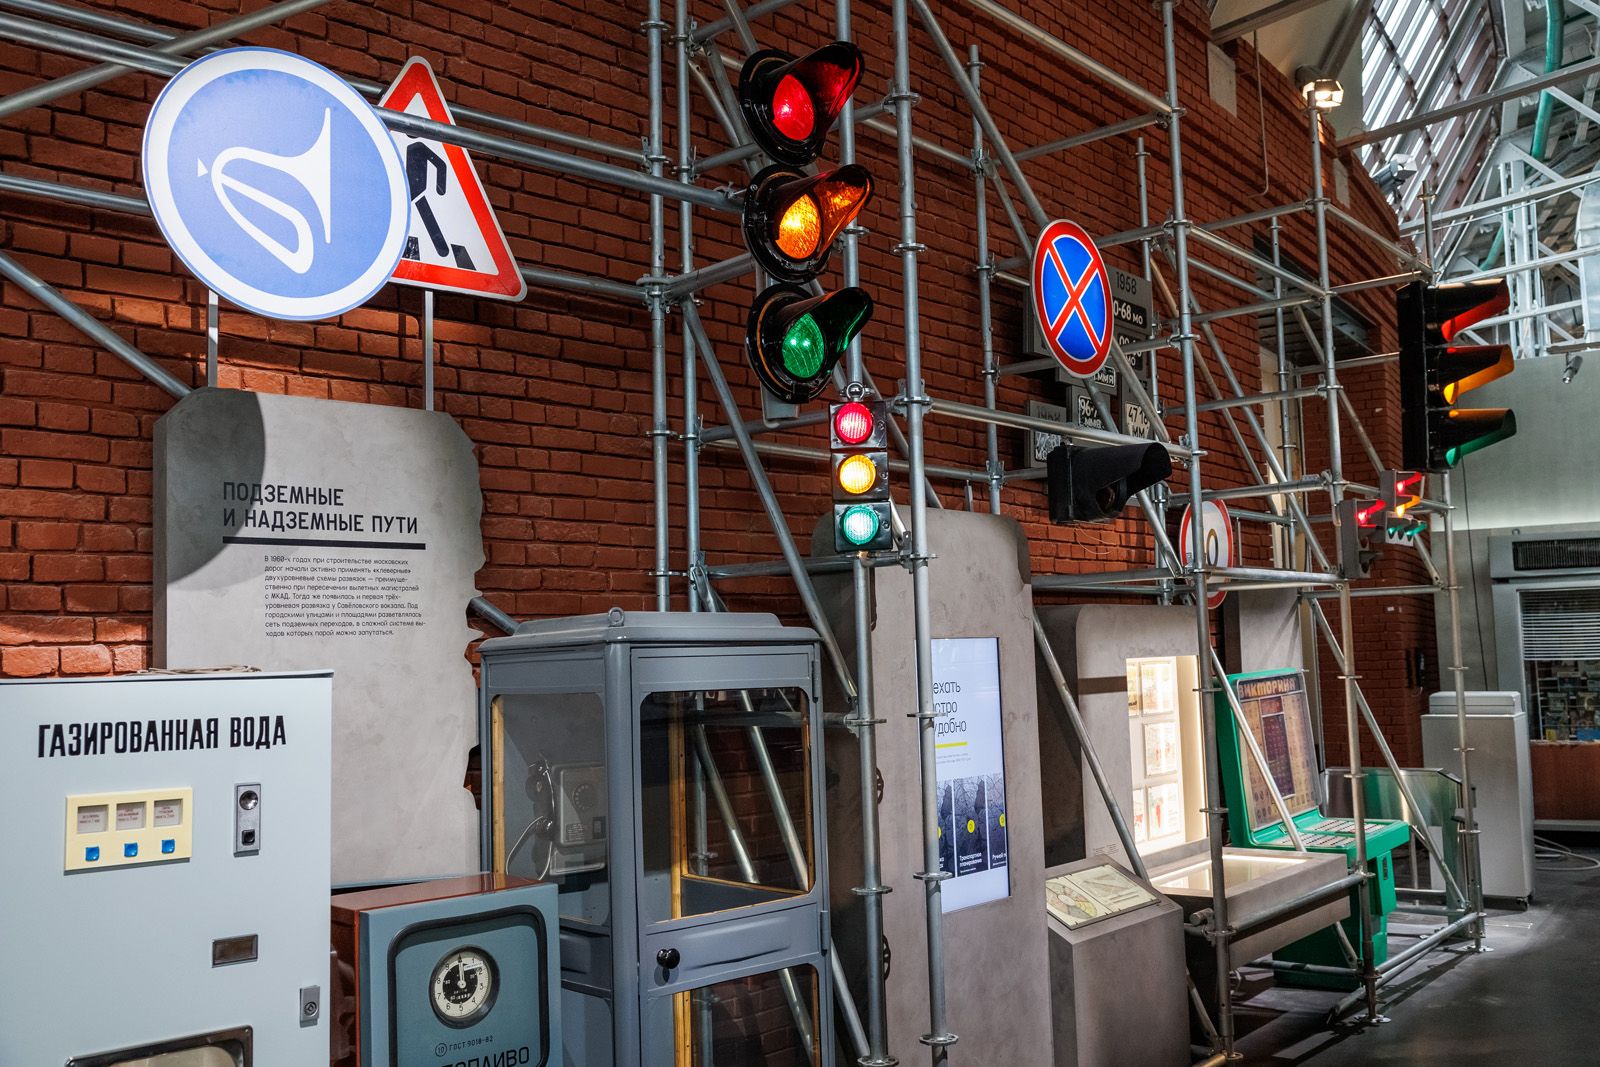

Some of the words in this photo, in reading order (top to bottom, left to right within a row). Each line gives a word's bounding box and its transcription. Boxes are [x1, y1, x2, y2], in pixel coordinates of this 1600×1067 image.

[1116, 271, 1137, 295] 1958
[223, 482, 344, 506] ПОДЗЕМНЫЕ
[223, 508, 235, 527] И
[244, 509, 364, 532] НАДЗЕМНЫЕ
[371, 515, 418, 534] ПУТИ
[292, 592, 310, 600] Тогда
[407, 602, 419, 610] Под
[314, 629, 334, 637] порой
[933, 681, 961, 695] ехать
[38, 717, 219, 758] ГАЗИРОВАННАЯ
[230, 715, 287, 750] ВОДА
[449, 1041, 466, 1051] ГОСТ
